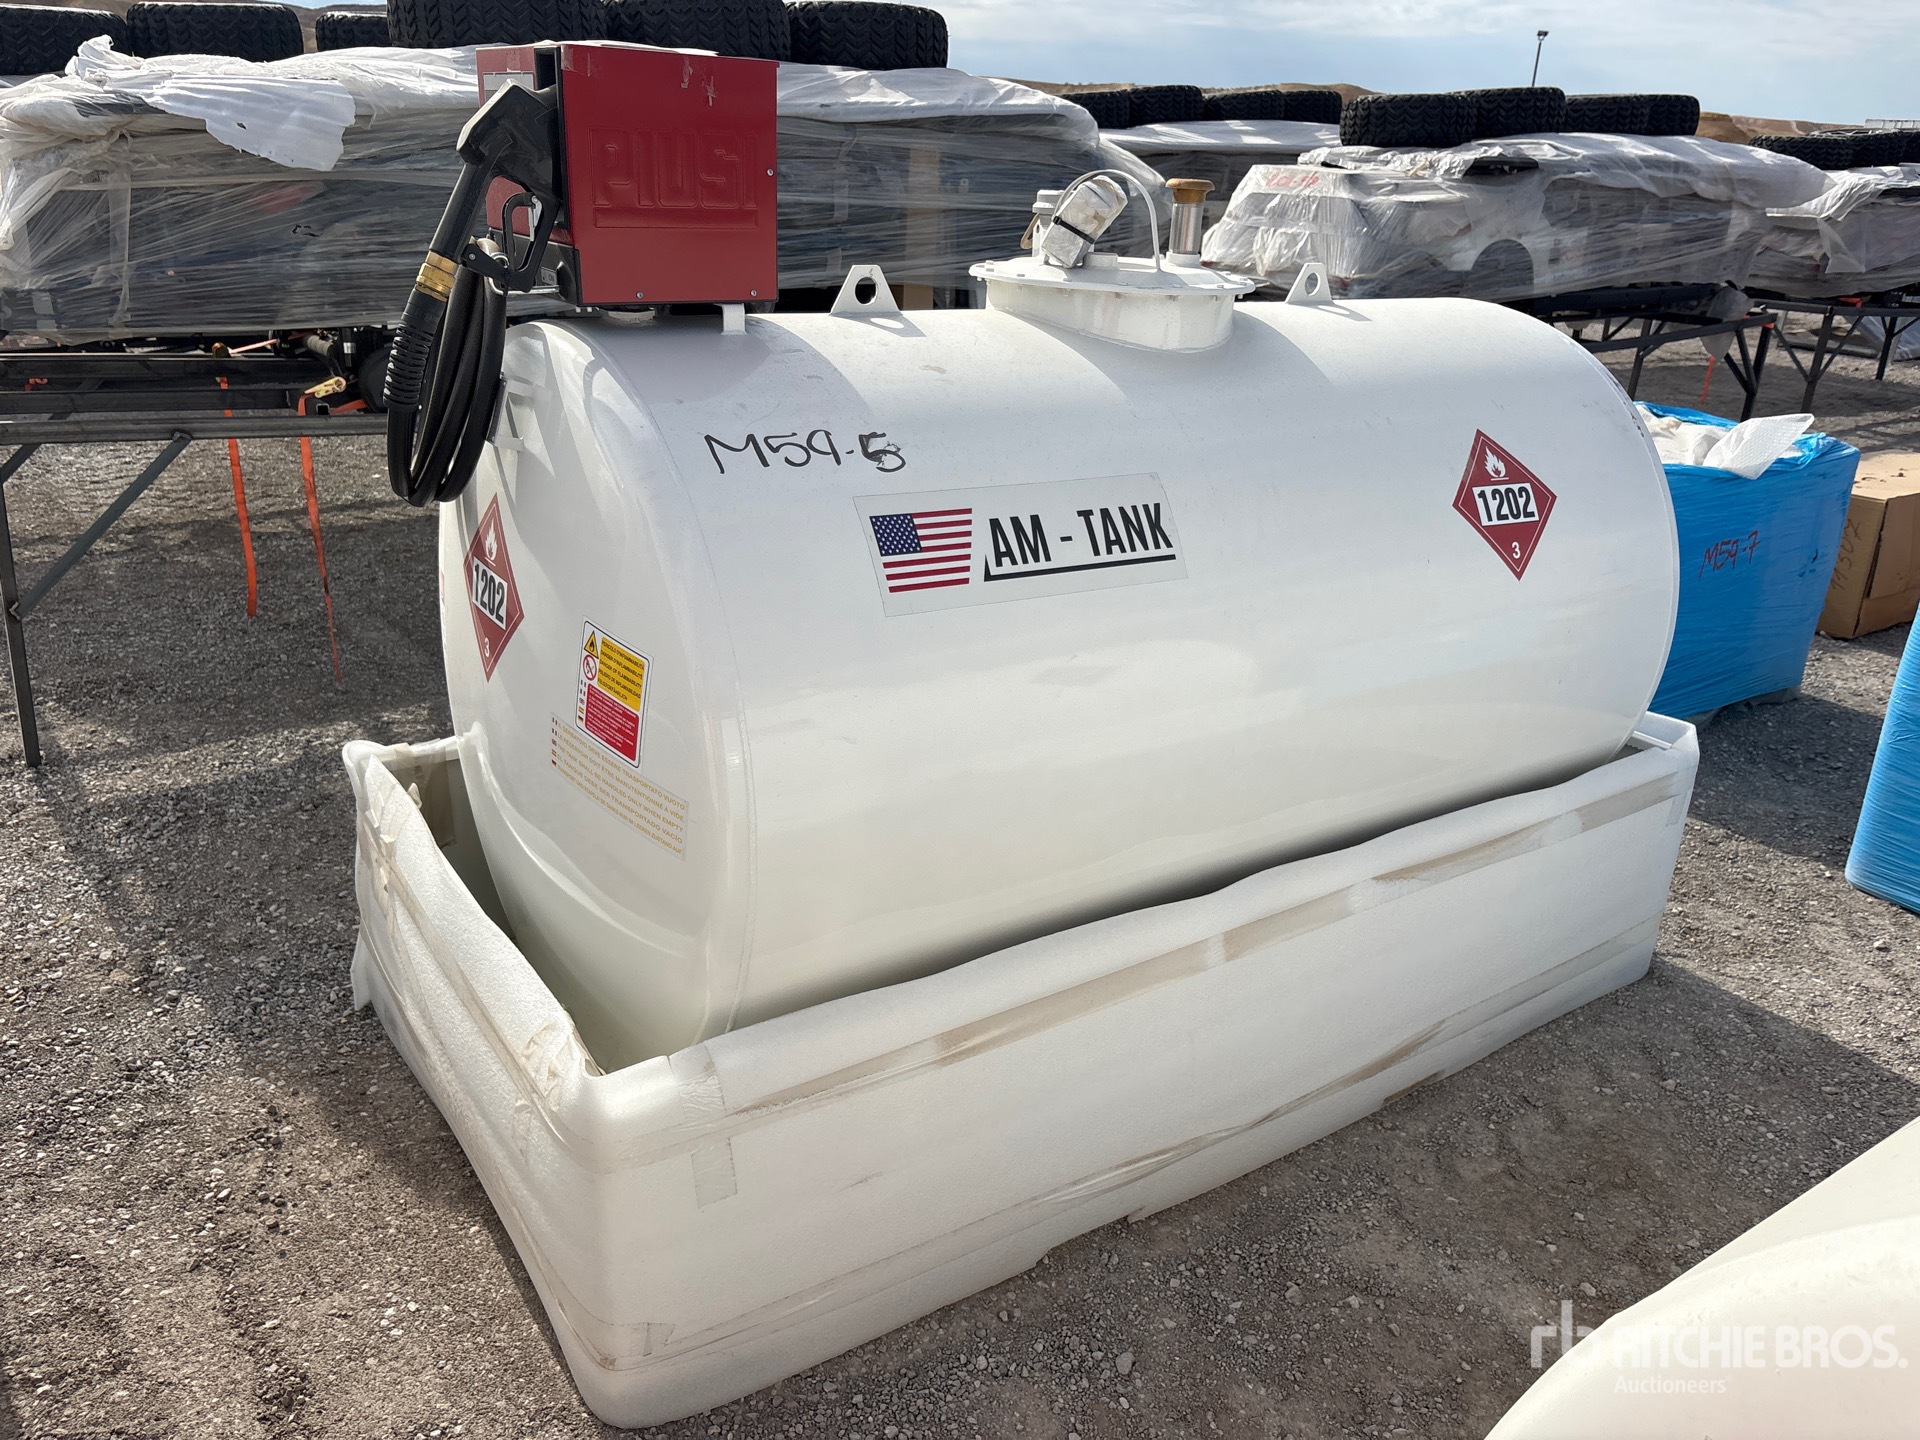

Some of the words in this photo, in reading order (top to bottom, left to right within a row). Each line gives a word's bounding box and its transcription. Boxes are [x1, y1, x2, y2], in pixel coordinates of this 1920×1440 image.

[1477, 486, 1536, 522] 1202
[989, 514, 1052, 568] AM
[1076, 502, 1174, 557] TANK
[1511, 541, 1521, 559] 3
[474, 563, 505, 625] 1202
[484, 637, 490, 657] 3
[579, 760, 593, 775] SHALL
[602, 777, 626, 798] HANDLED
[627, 795, 642, 808] ONLY
[643, 804, 661, 820] WHEN
[662, 817, 684, 832] EMPTY
[601, 755, 621, 772] ESSERE
[622, 769, 662, 797] TRASPORTATO
[663, 794, 685, 811] VUOTO
[611, 795, 660, 831] TRANSPORTADO
